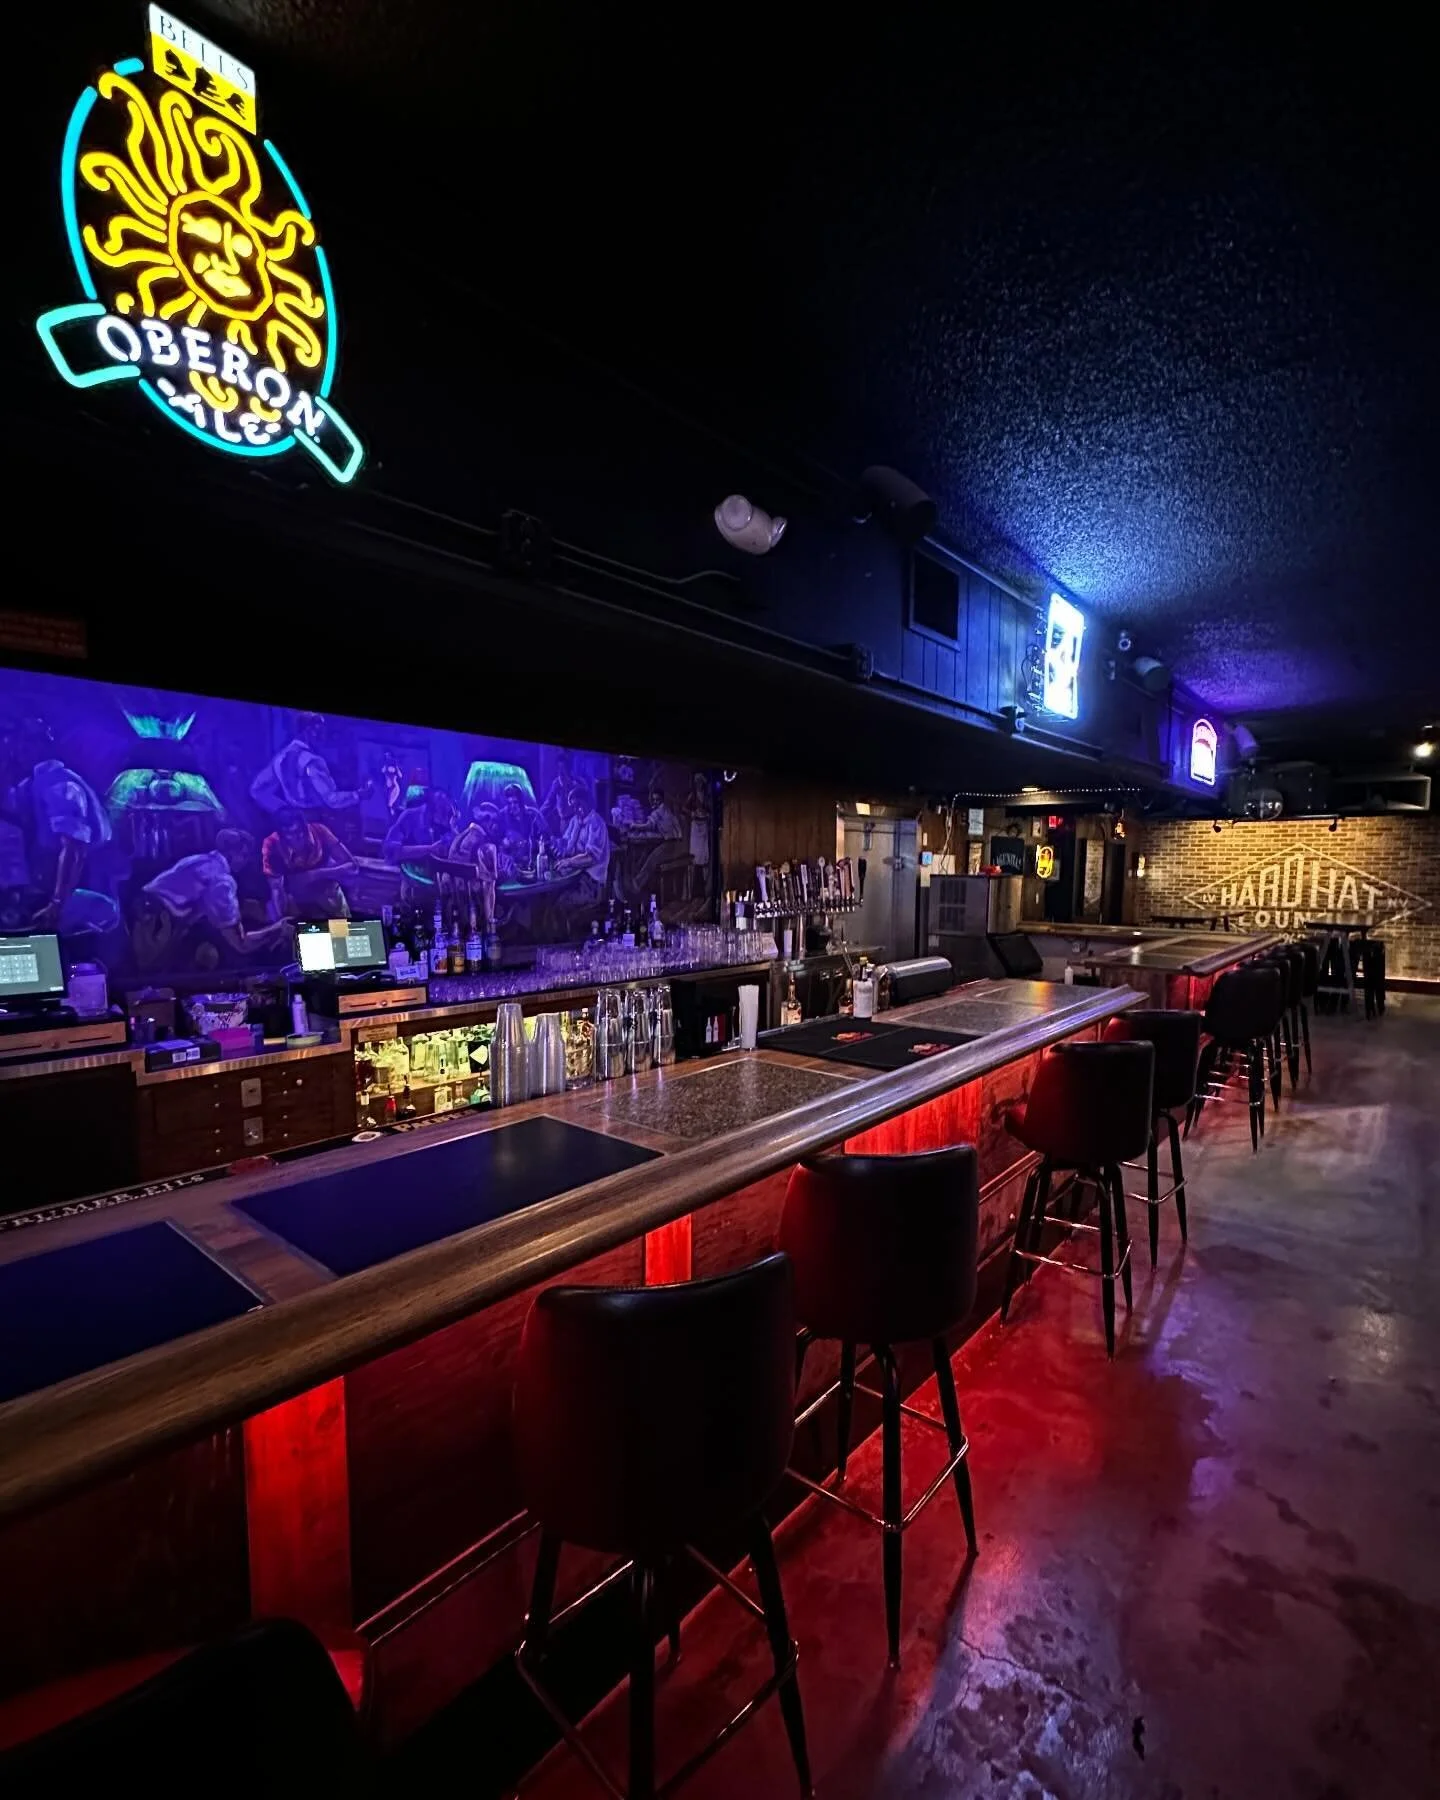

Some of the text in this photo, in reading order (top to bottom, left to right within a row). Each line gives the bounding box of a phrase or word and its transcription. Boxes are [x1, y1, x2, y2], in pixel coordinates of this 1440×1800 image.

[97, 315, 324, 442] OBERON
[1220, 854, 1383, 910] HARD HAT
